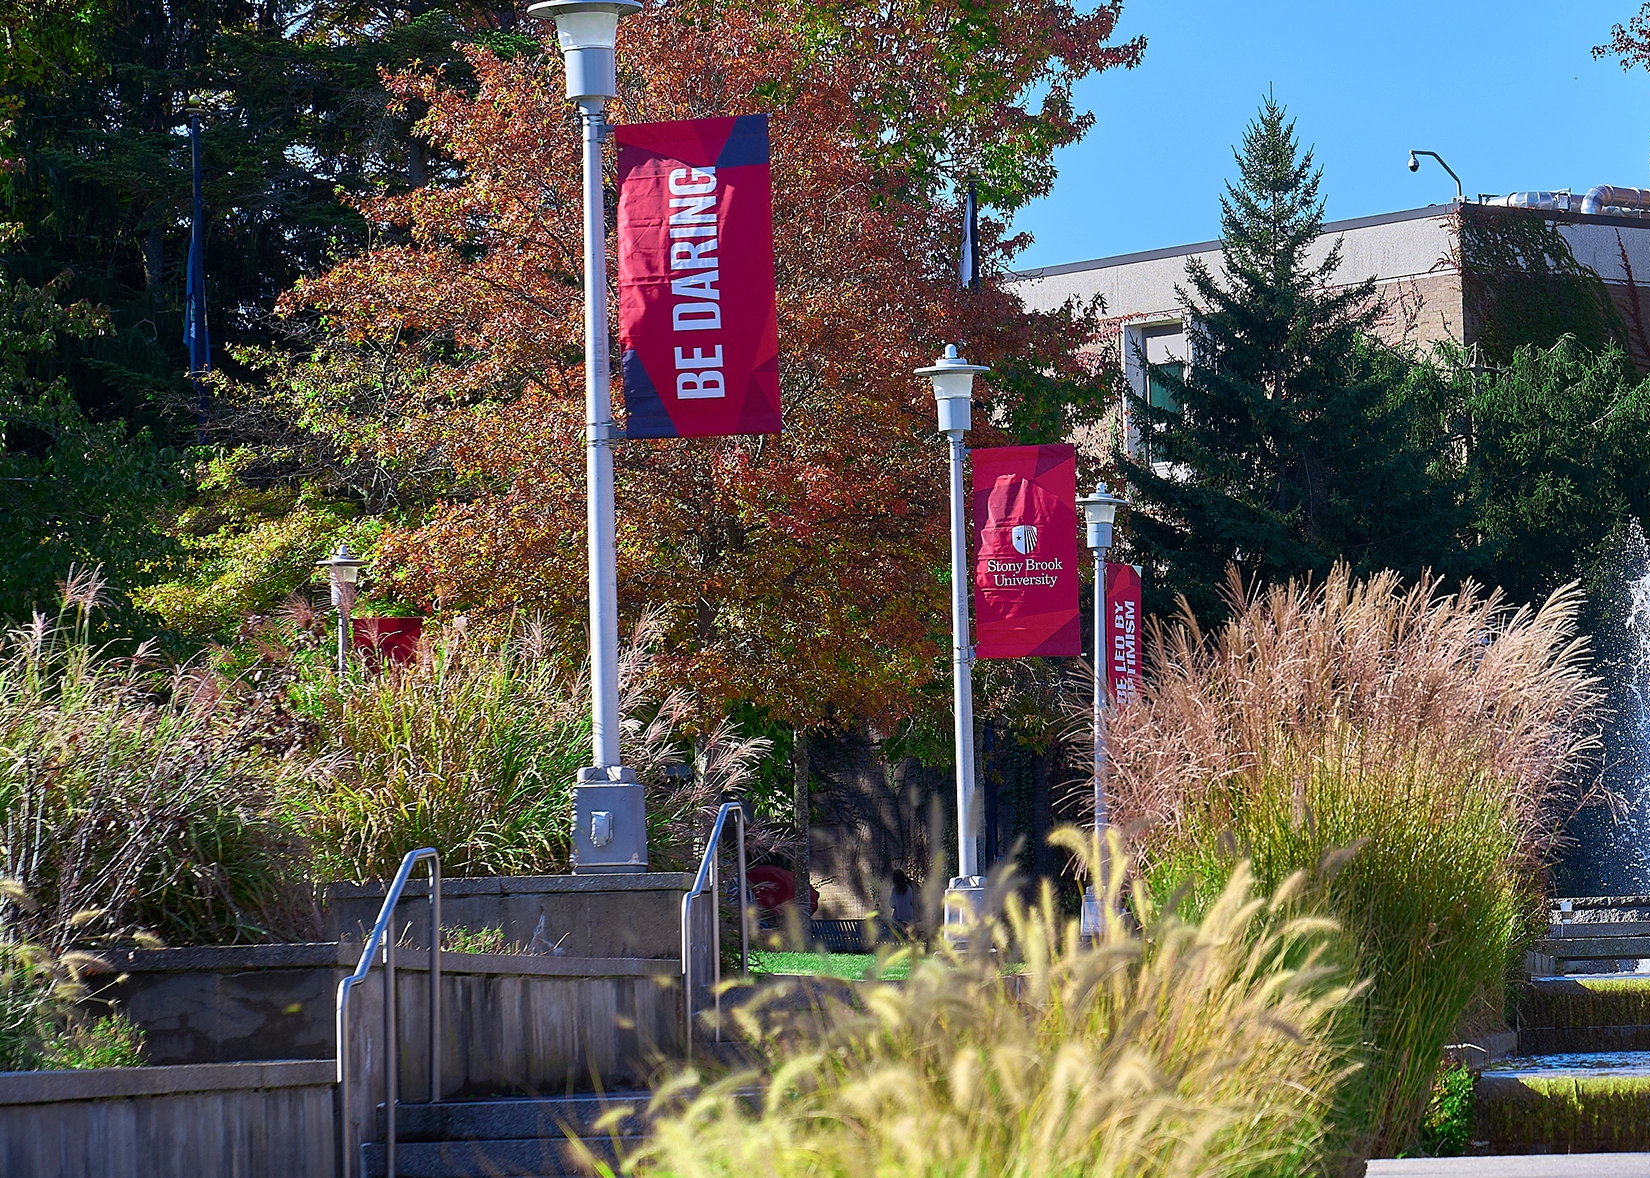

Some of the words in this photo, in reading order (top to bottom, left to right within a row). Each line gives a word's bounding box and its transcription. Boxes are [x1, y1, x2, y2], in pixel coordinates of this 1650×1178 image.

[668, 166, 721, 331] DARING
[674, 344, 725, 400] BE
[987, 559, 1023, 574] Stony
[1025, 557, 1063, 571] Brook
[993, 572, 1058, 587] University
[1114, 600, 1125, 629] BY
[1114, 635, 1126, 672] LED
[1116, 677, 1127, 704] BE
